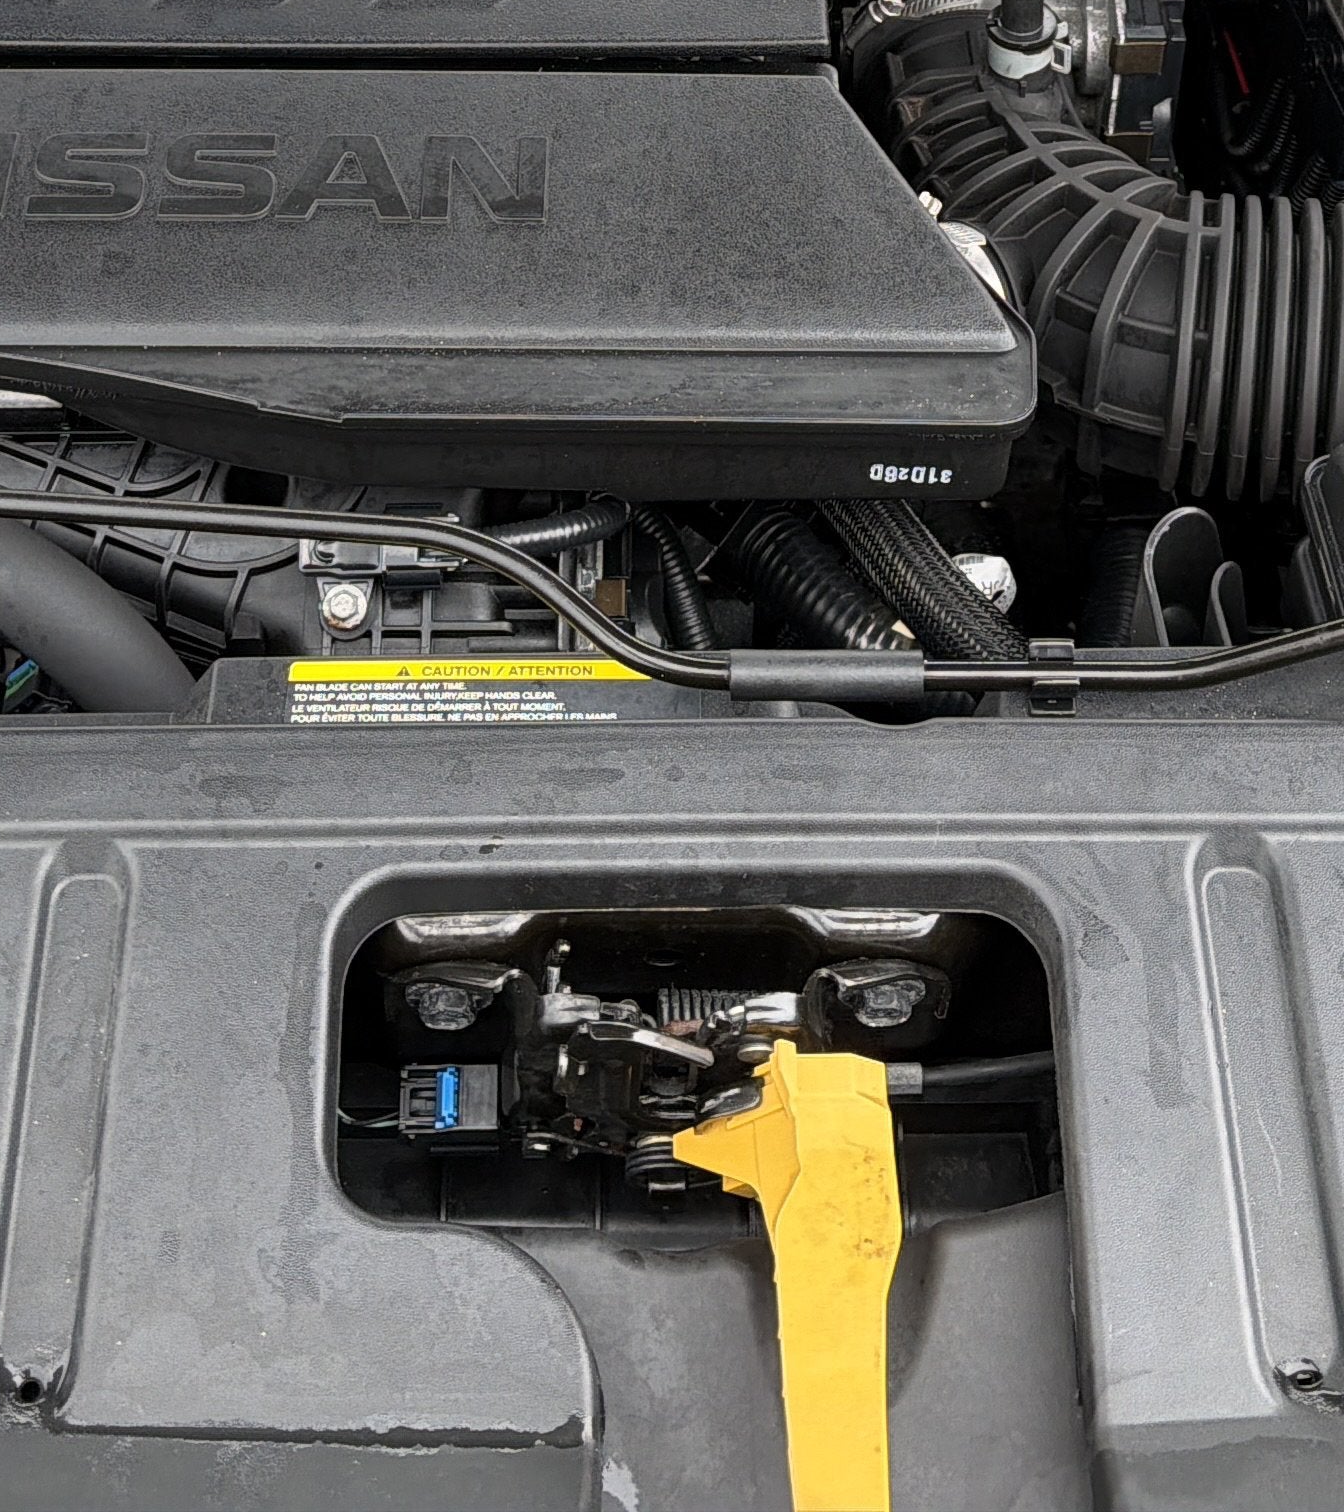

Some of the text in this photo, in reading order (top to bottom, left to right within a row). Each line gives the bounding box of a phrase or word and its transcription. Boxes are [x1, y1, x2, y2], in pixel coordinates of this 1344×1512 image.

[421, 665, 491, 677] CAUTION
[508, 665, 594, 677] ATTENTION
[294, 683, 314, 691] FAN
[315, 683, 348, 691] BLADE
[350, 683, 372, 691] CAN
[374, 683, 405, 691] START
[406, 682, 418, 691] AT
[420, 682, 441, 691] ANY
[293, 693, 307, 702] TO
[309, 693, 335, 701] HELP
[336, 693, 367, 701] AVOID
[369, 693, 422, 701] PERSONAL
[485, 692, 520, 700] HANDS
[292, 704, 305, 712] LE
[307, 703, 370, 712] VENTILATEUR
[372, 703, 409, 712] RISQUE
[411, 703, 425, 711] DE
[492, 702, 519, 711] TOUT
[291, 715, 320, 723] POUR
[357, 714, 390, 722] TOUTE
[447, 714, 462, 722] NE
[463, 713, 483, 722] PAS
[485, 713, 499, 721] EN
